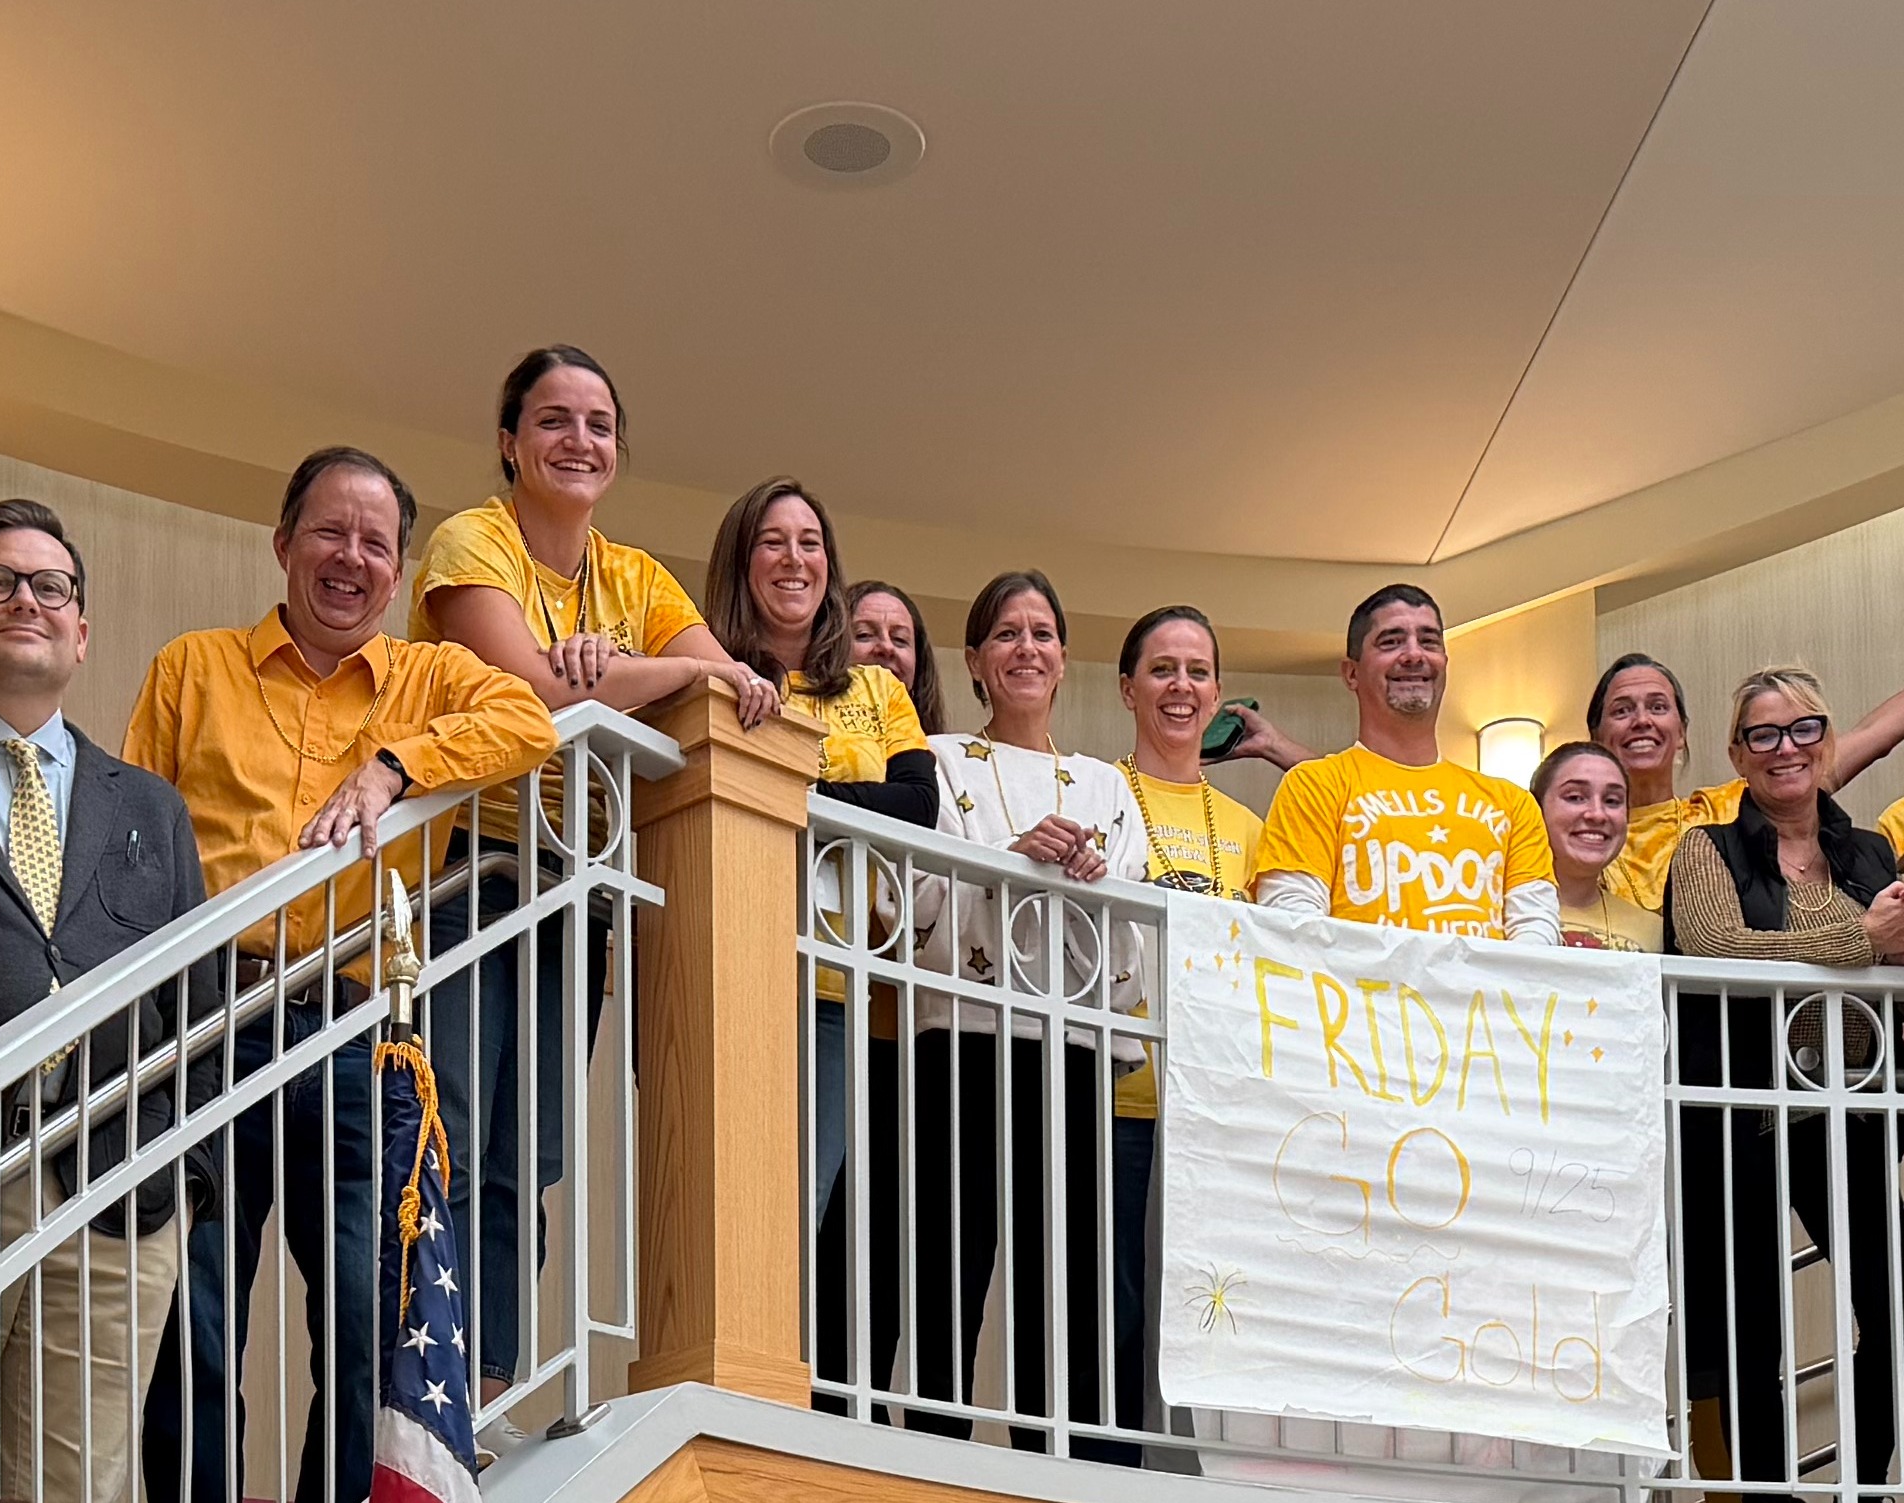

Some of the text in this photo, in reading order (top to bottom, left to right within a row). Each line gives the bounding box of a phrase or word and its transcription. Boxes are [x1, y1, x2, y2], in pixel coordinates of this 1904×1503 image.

[1343, 789, 1512, 846] SMELLS LIKE
[1252, 953, 1560, 1126] FRIDAY
[1272, 1109, 1632, 1246] GO 9/25
[1388, 1270, 1603, 1404] Gold
